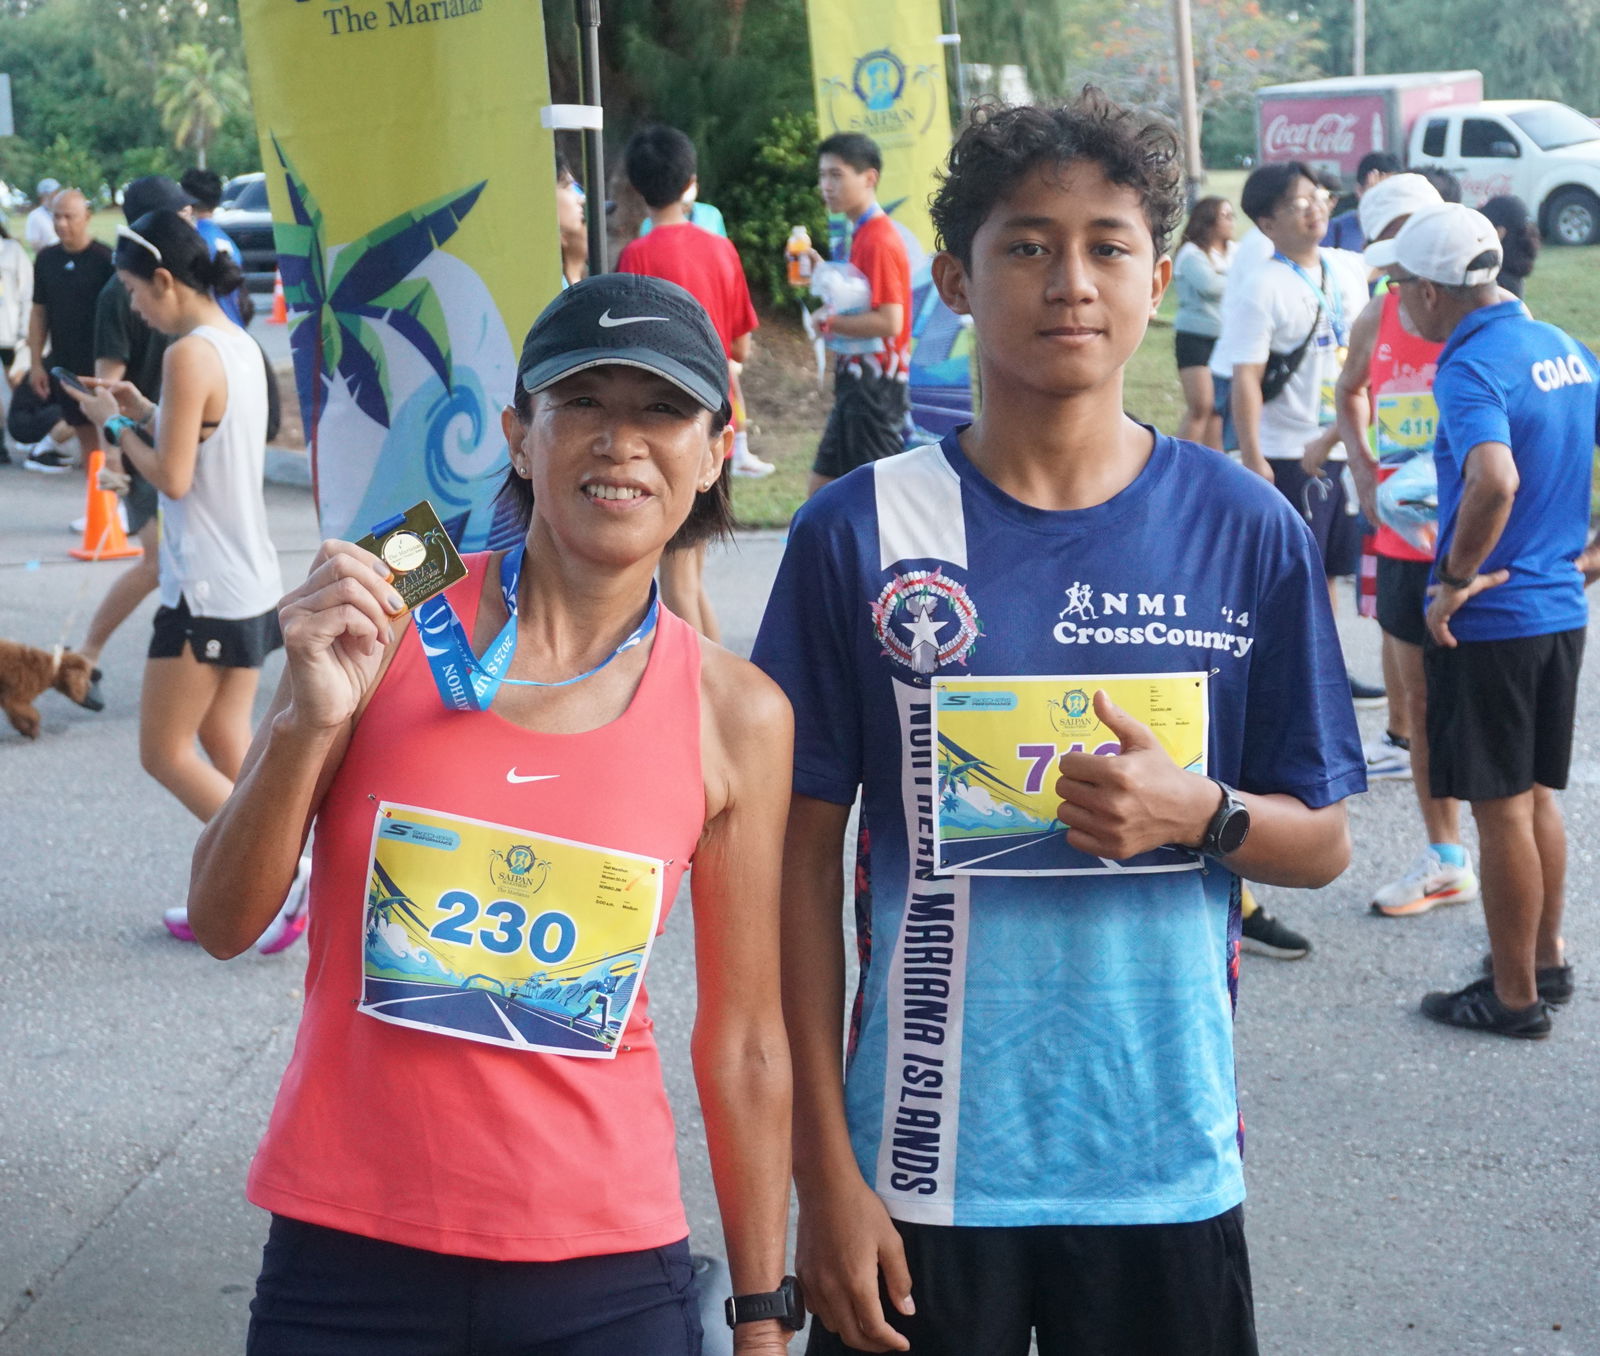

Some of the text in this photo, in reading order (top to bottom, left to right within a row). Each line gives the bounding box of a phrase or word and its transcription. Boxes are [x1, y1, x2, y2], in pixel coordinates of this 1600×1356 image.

[323, 5, 378, 35] The
[1531, 354, 1593, 392] COAC
[1399, 418, 1434, 436] 411
[474, 635, 513, 698] 2025 SIP
[1060, 718, 1091, 726] SAIPAN
[498, 872, 533, 886] SAIPAN
[430, 891, 576, 964] 230
[904, 892, 955, 1046] MARIANA
[890, 1053, 944, 1195] ISLANDS
